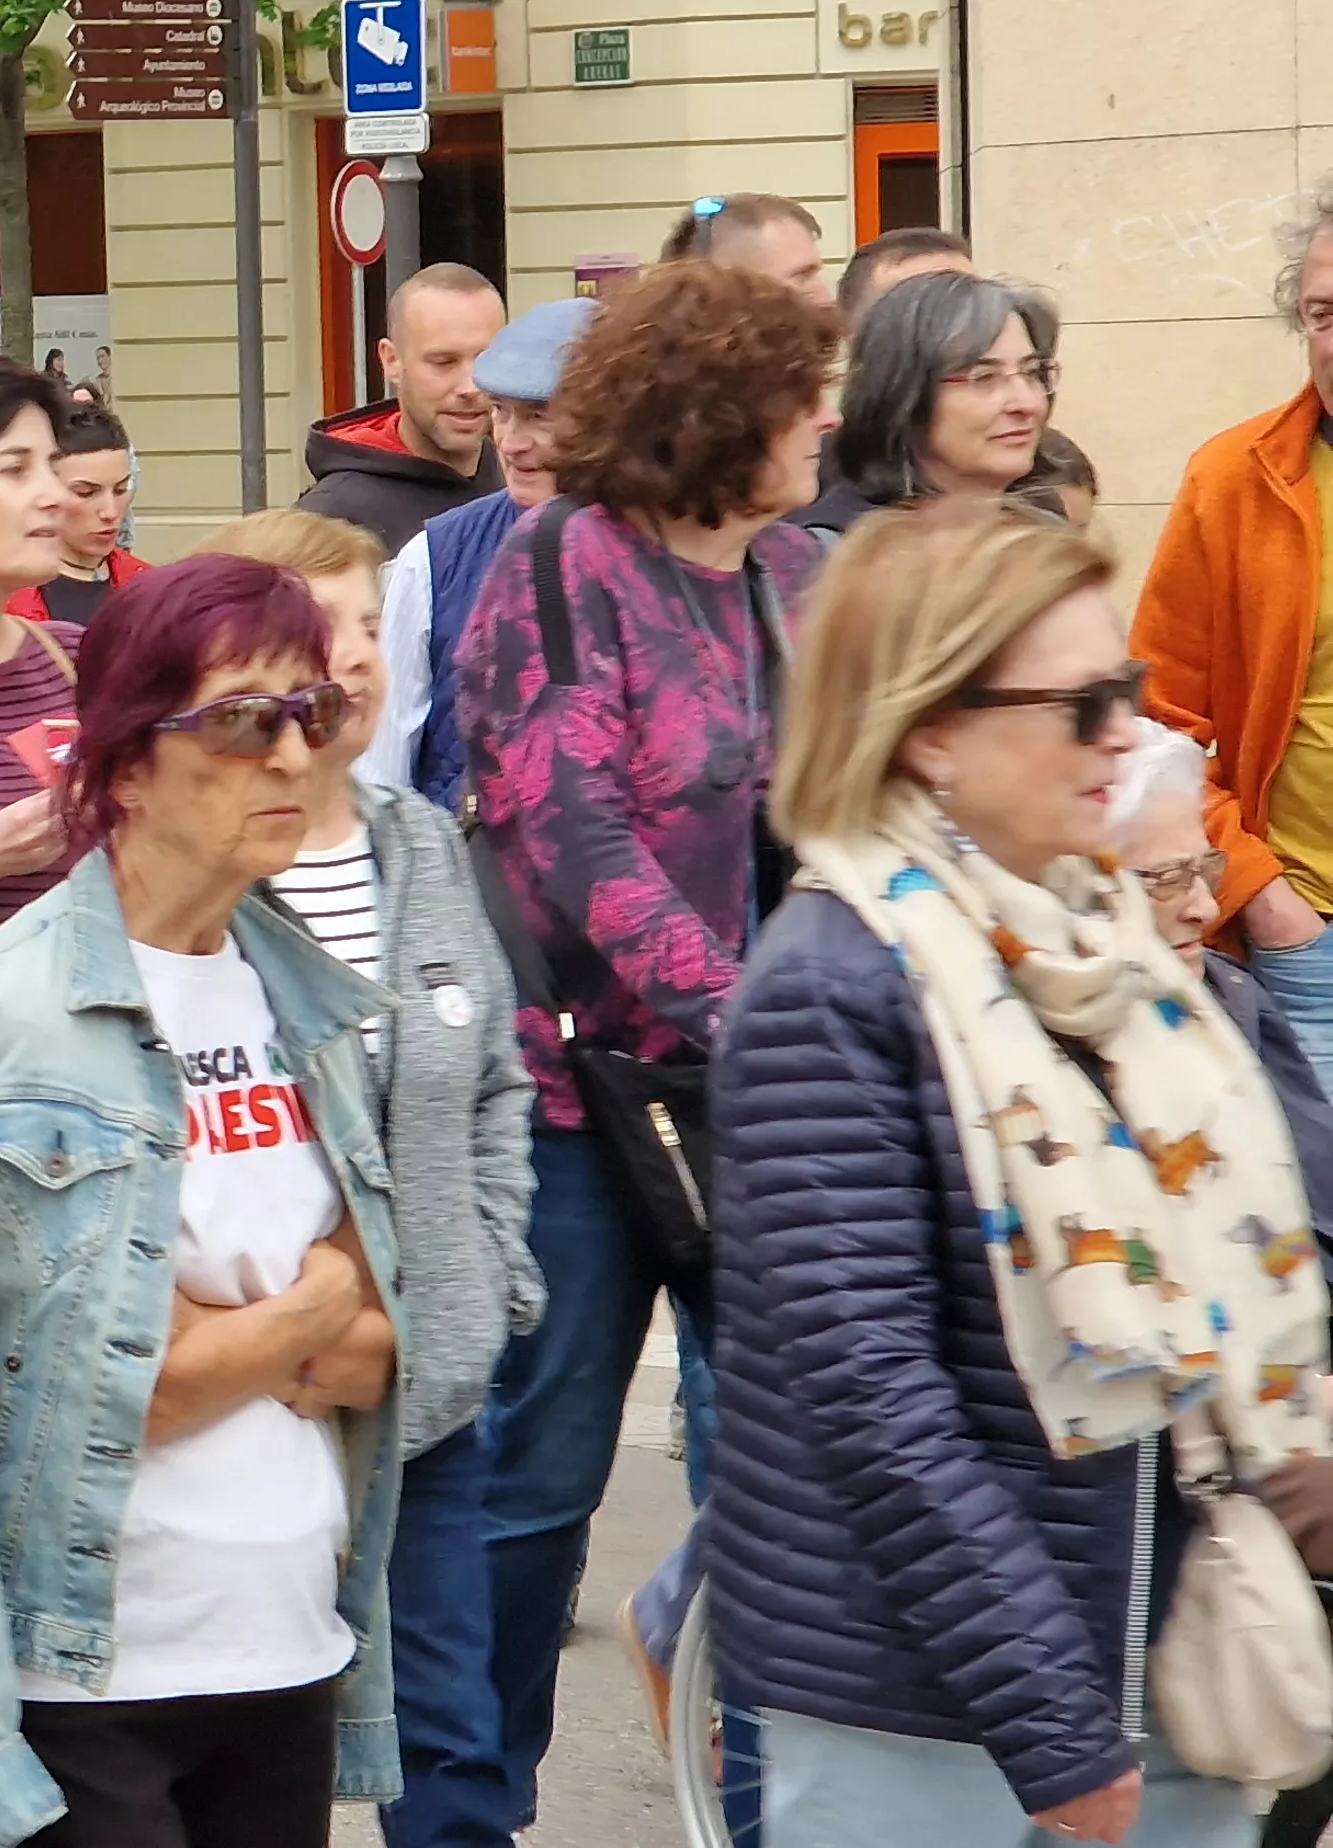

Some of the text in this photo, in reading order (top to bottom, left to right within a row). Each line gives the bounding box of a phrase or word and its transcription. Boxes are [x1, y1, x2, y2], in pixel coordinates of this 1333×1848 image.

[122, 1, 204, 13] Museo Diocesano
[165, 29, 205, 42] Catedral
[143, 58, 206, 73] Ayuntamiento
[173, 86, 205, 98] Museo
[99, 100, 205, 114] Arqueológico Provincial
